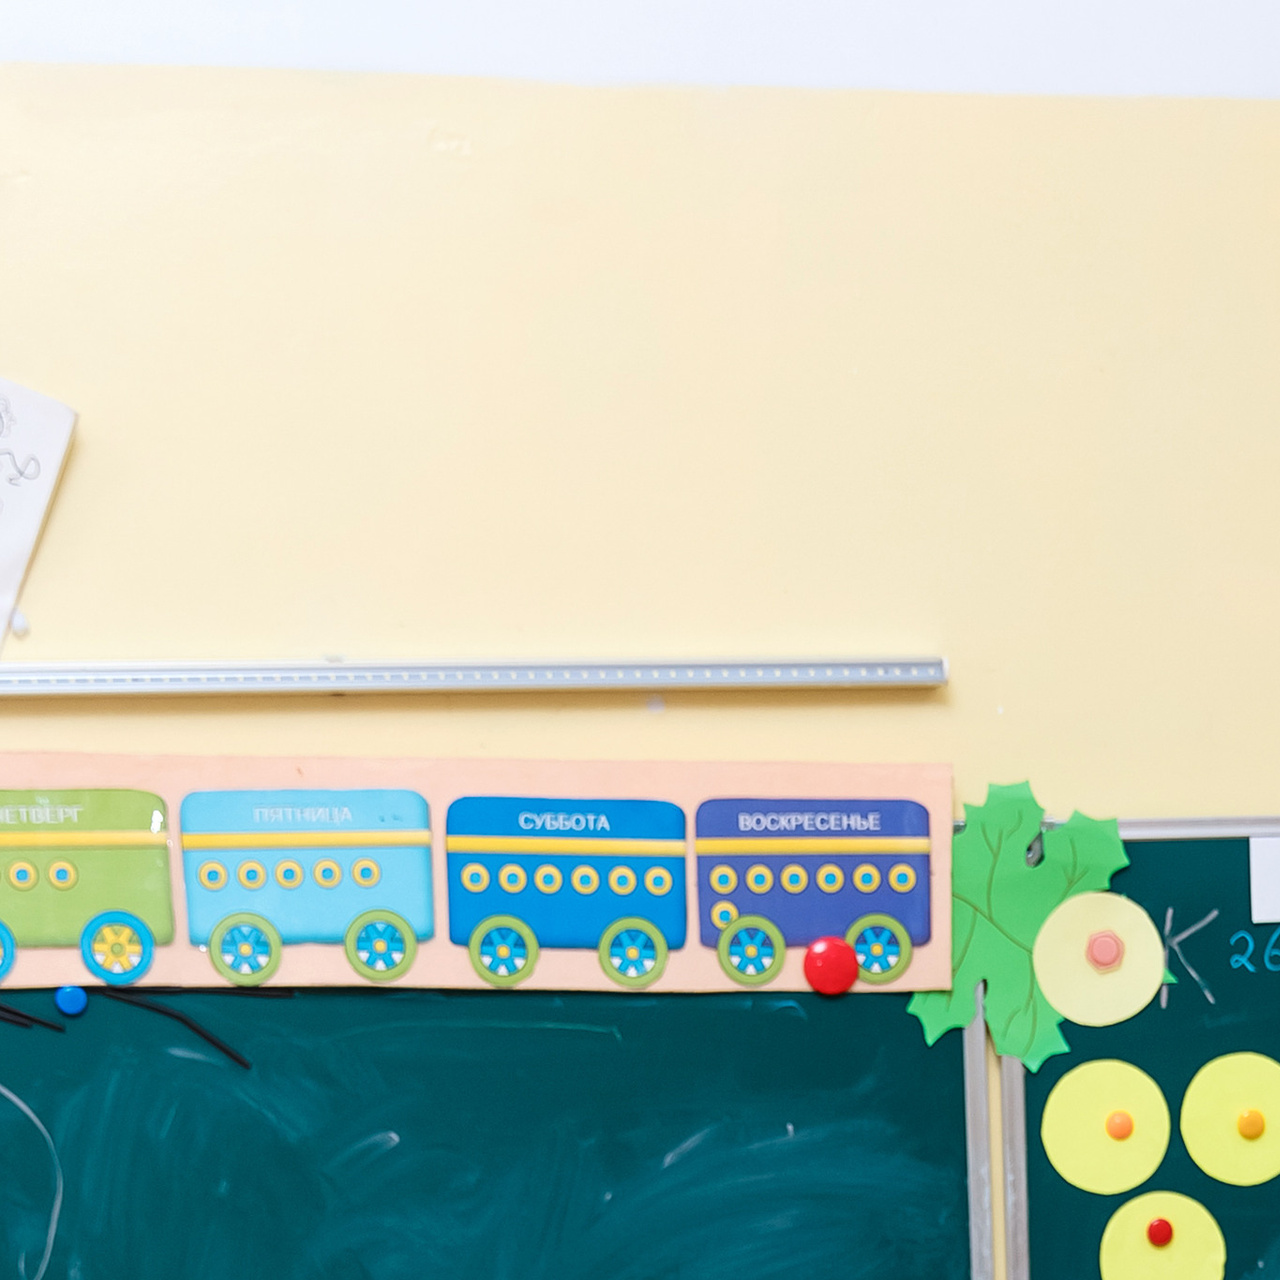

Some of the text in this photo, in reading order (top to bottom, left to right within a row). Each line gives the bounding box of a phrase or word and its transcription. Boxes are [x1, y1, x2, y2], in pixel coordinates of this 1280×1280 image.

[0, 805, 84, 824] ЕТВЕРГ
[253, 805, 353, 824] ПЯТНИЦА
[518, 811, 610, 831] СУББОТА
[738, 812, 881, 832] ВОСКРЕСЕНЬЕ
